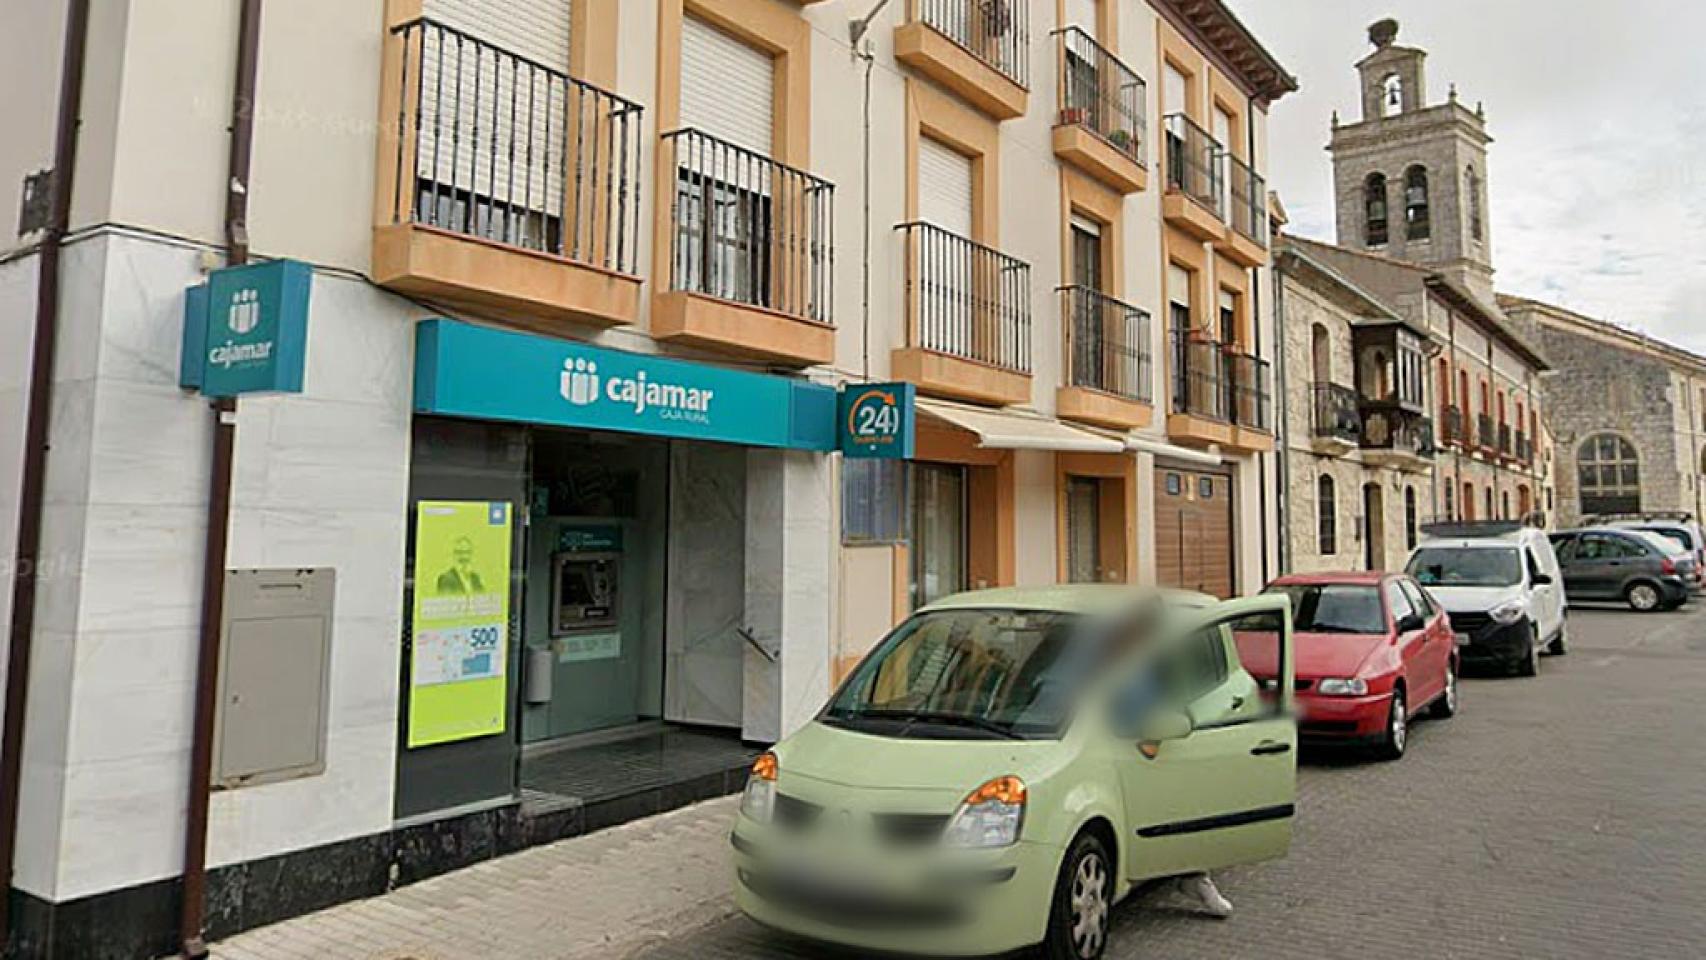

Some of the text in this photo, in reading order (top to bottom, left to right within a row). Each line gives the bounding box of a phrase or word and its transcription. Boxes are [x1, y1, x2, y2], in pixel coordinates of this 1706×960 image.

[208, 340, 272, 369] cajamar
[606, 370, 713, 414] cajamar
[469, 626, 499, 648] 500
